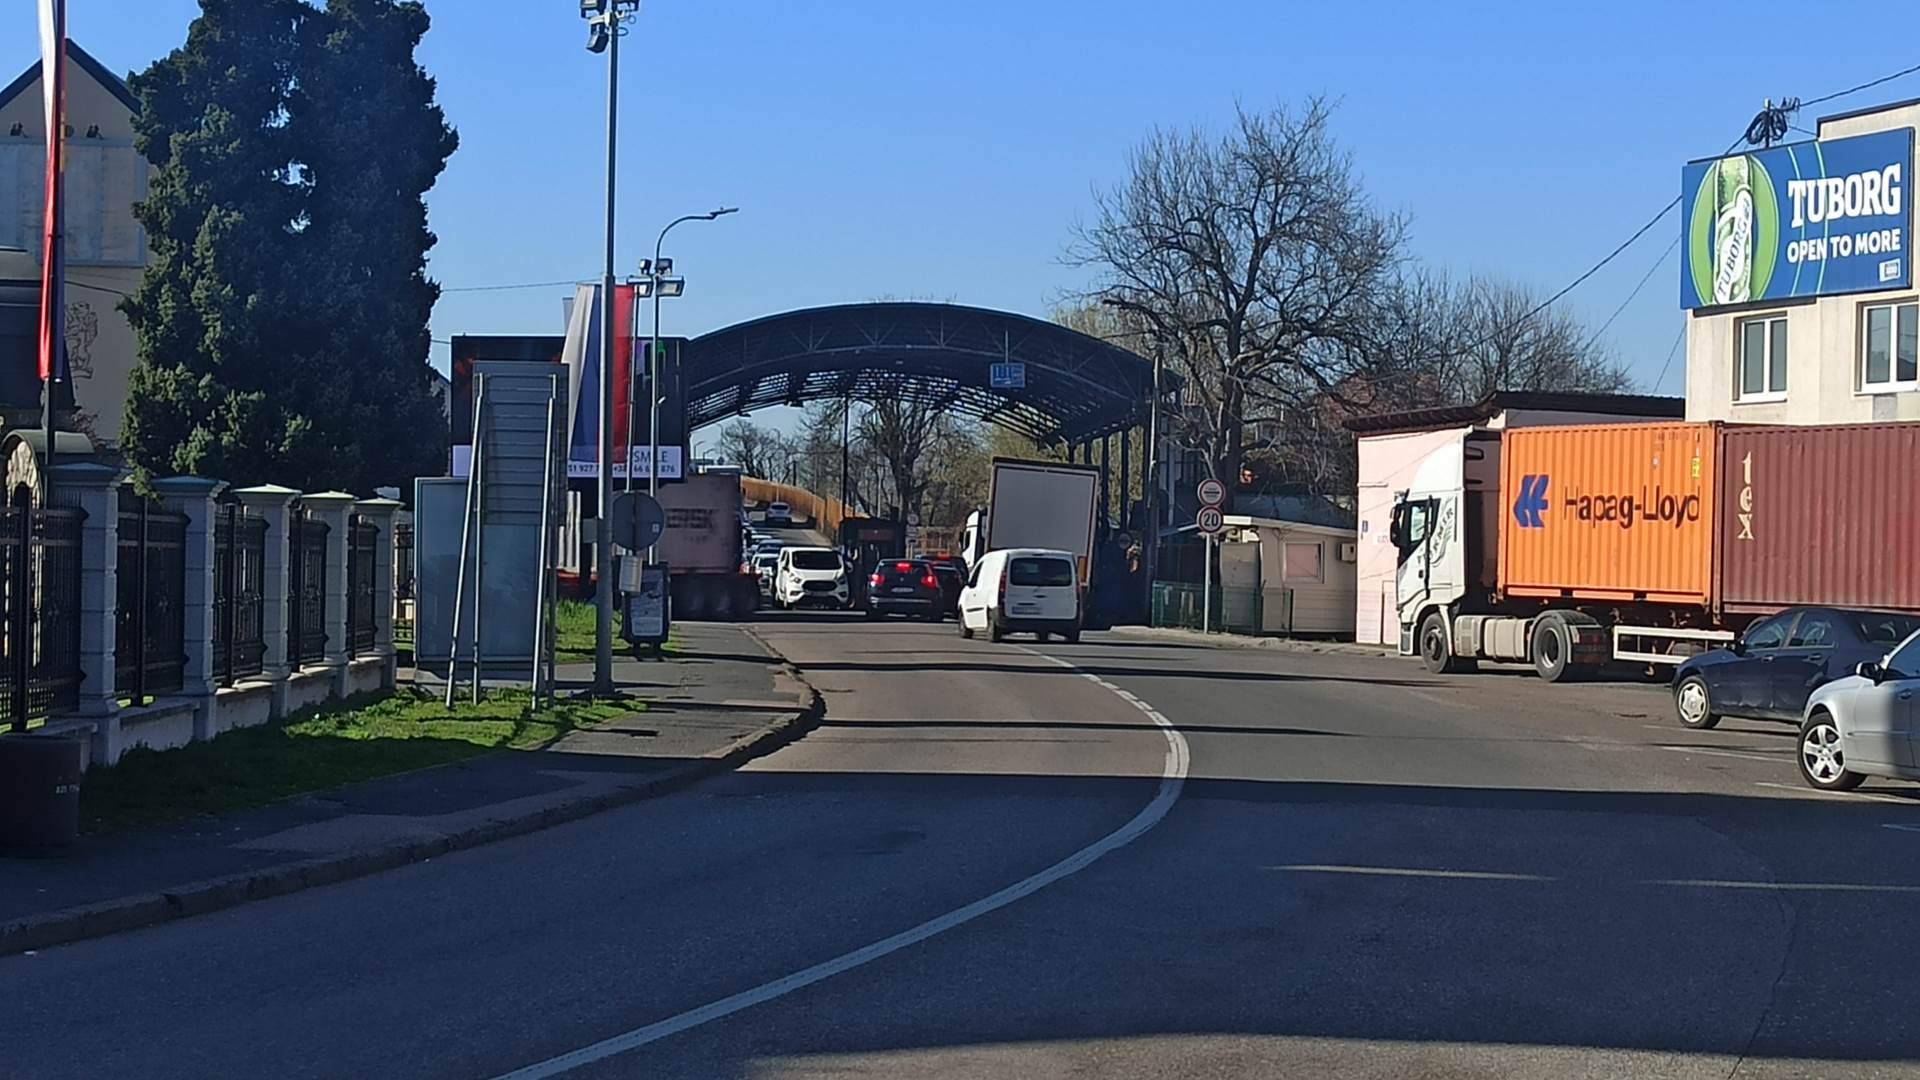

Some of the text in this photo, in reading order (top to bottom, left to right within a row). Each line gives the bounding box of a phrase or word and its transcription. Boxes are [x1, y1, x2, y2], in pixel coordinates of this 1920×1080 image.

[1787, 163, 1901, 228] TUBORG
[1787, 228, 1901, 264] OPEN TO MORE
[1564, 485, 1701, 529] Hapag-Lloyd
[1737, 450, 1754, 540] tex
[1203, 512, 1219, 527] 20
